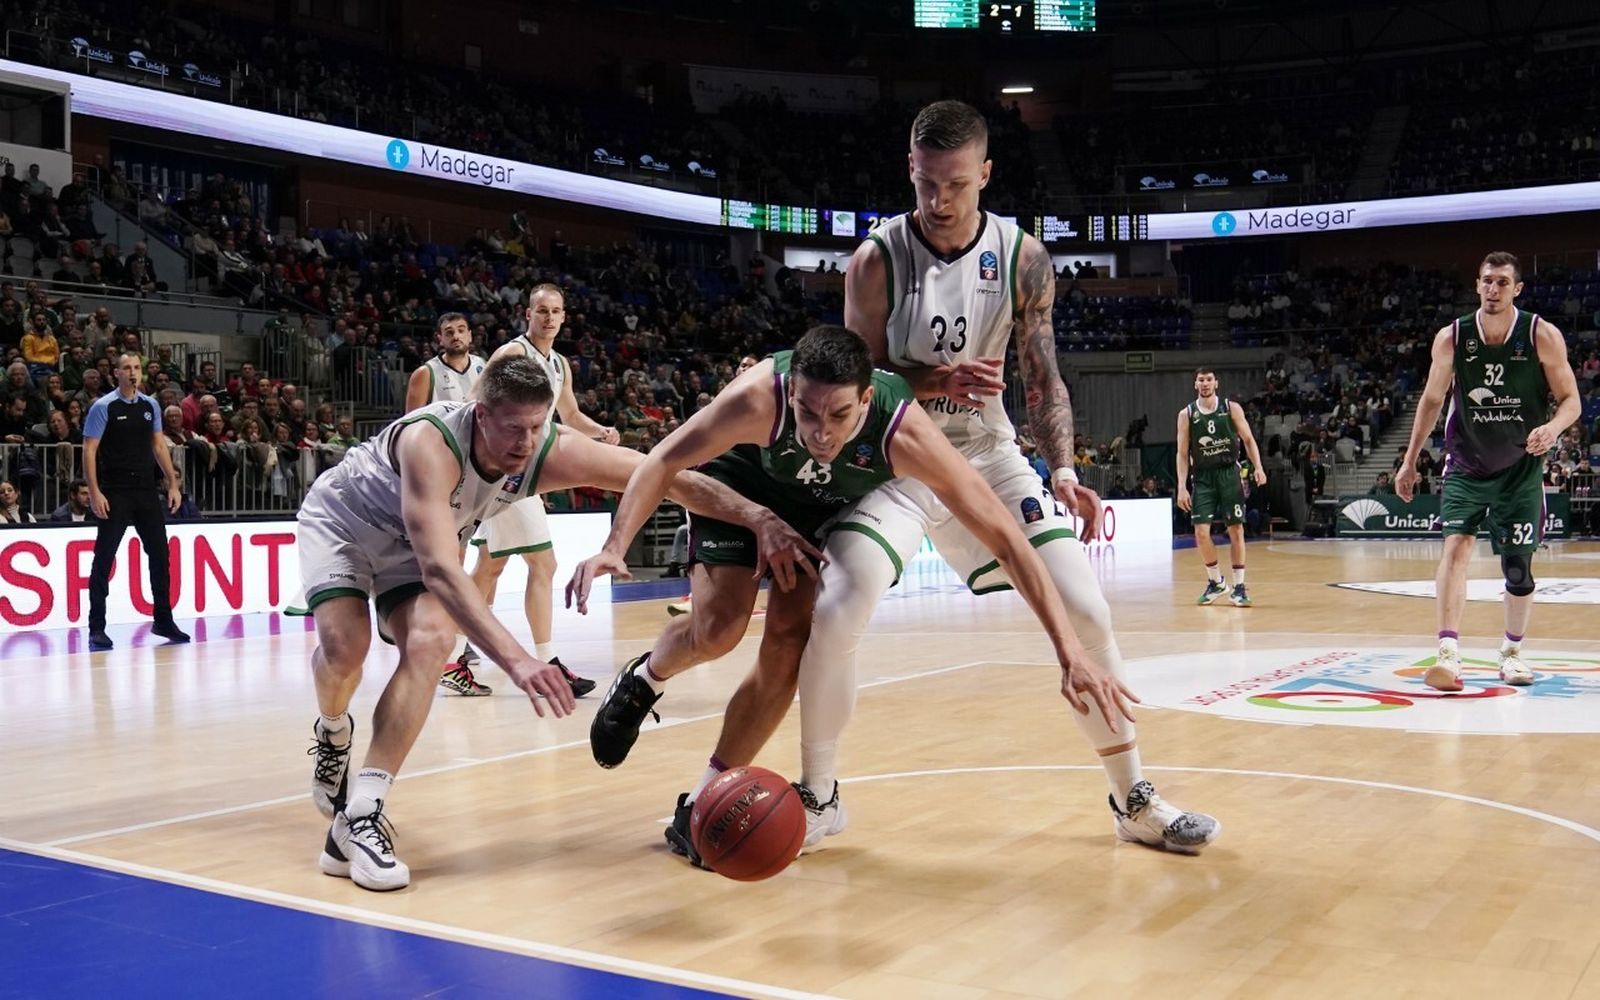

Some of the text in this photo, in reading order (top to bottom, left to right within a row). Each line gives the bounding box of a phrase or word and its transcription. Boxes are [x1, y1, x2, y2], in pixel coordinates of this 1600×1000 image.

[990, 4, 999, 17] 2
[420, 146, 515, 185] Madegar
[1248, 208, 1357, 230] Madegar
[930, 315, 967, 353] 23
[1483, 363, 1504, 386] 32
[1207, 420, 1216, 434] 8
[796, 458, 832, 485] 43
[1234, 504, 1243, 518] 8
[1385, 513, 1436, 531] Unicaj
[1512, 522, 1534, 546] 32
